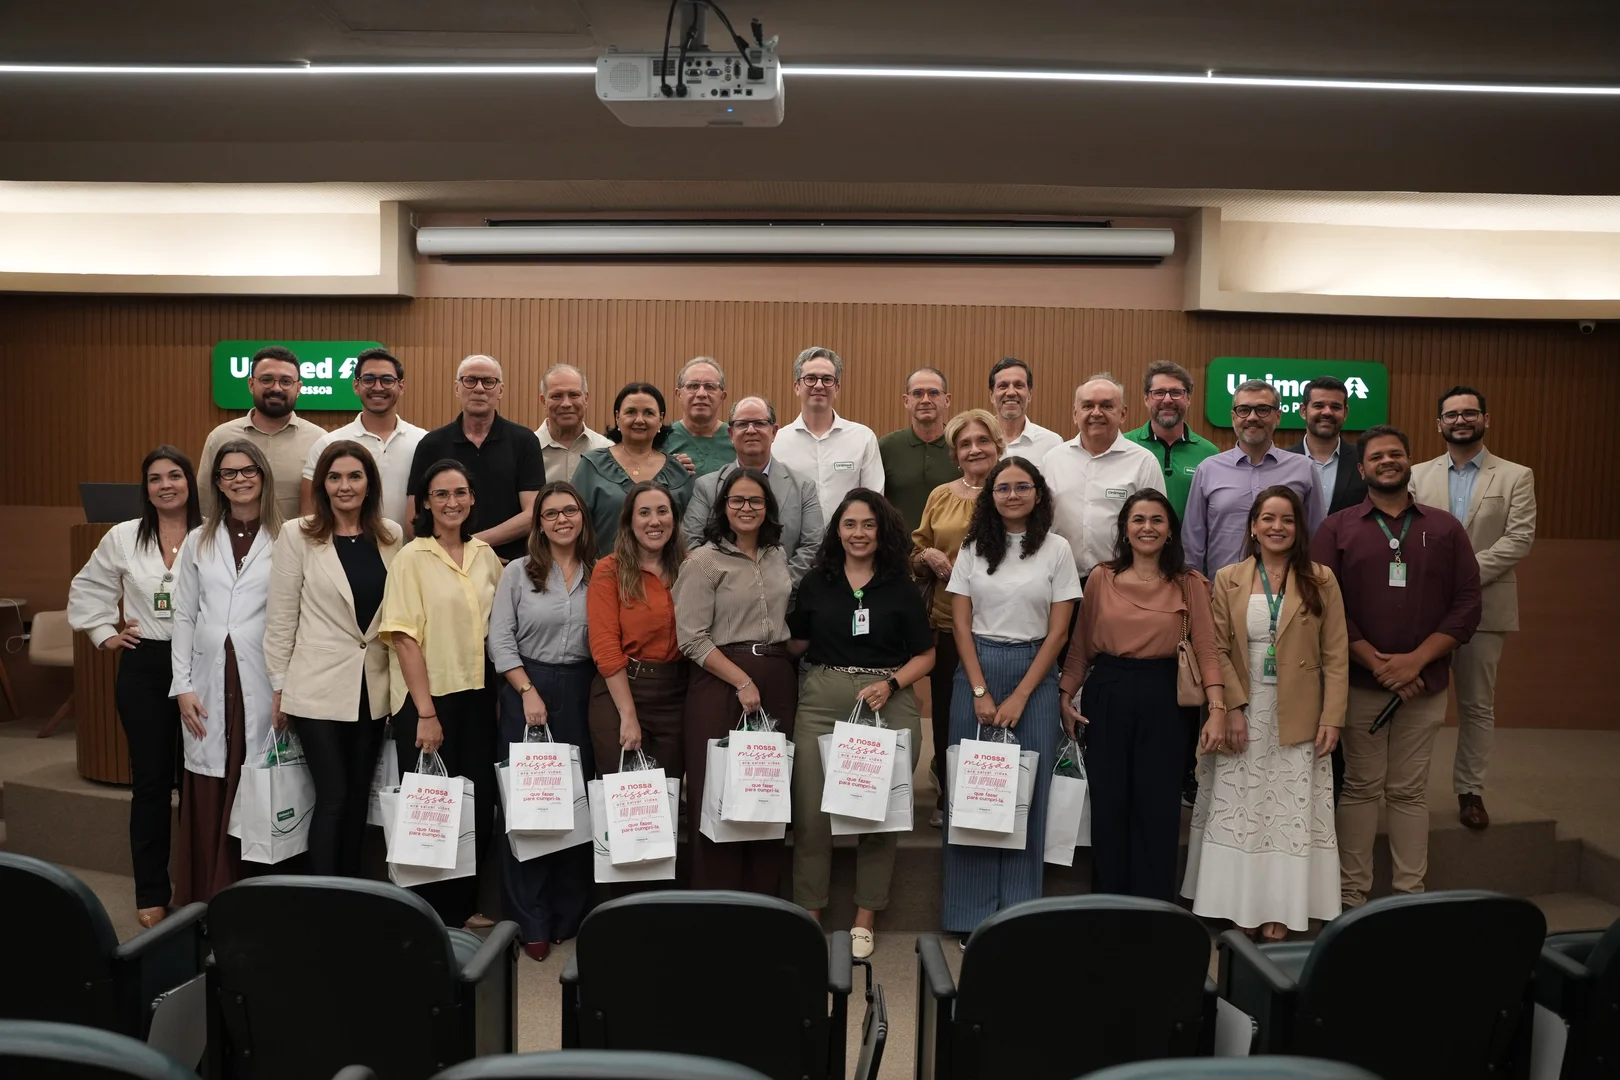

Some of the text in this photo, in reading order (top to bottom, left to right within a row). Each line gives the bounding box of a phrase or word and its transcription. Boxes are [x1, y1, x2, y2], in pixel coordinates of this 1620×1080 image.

[230, 357, 332, 378] Ued
[300, 385, 332, 395] essoa
[857, 739, 880, 747] nossa
[838, 743, 889, 755] missão
[738, 750, 784, 760] missão
[516, 760, 566, 770] missão
[964, 760, 1013, 769] missão
[407, 793, 456, 804] missão
[612, 789, 661, 800] missão
